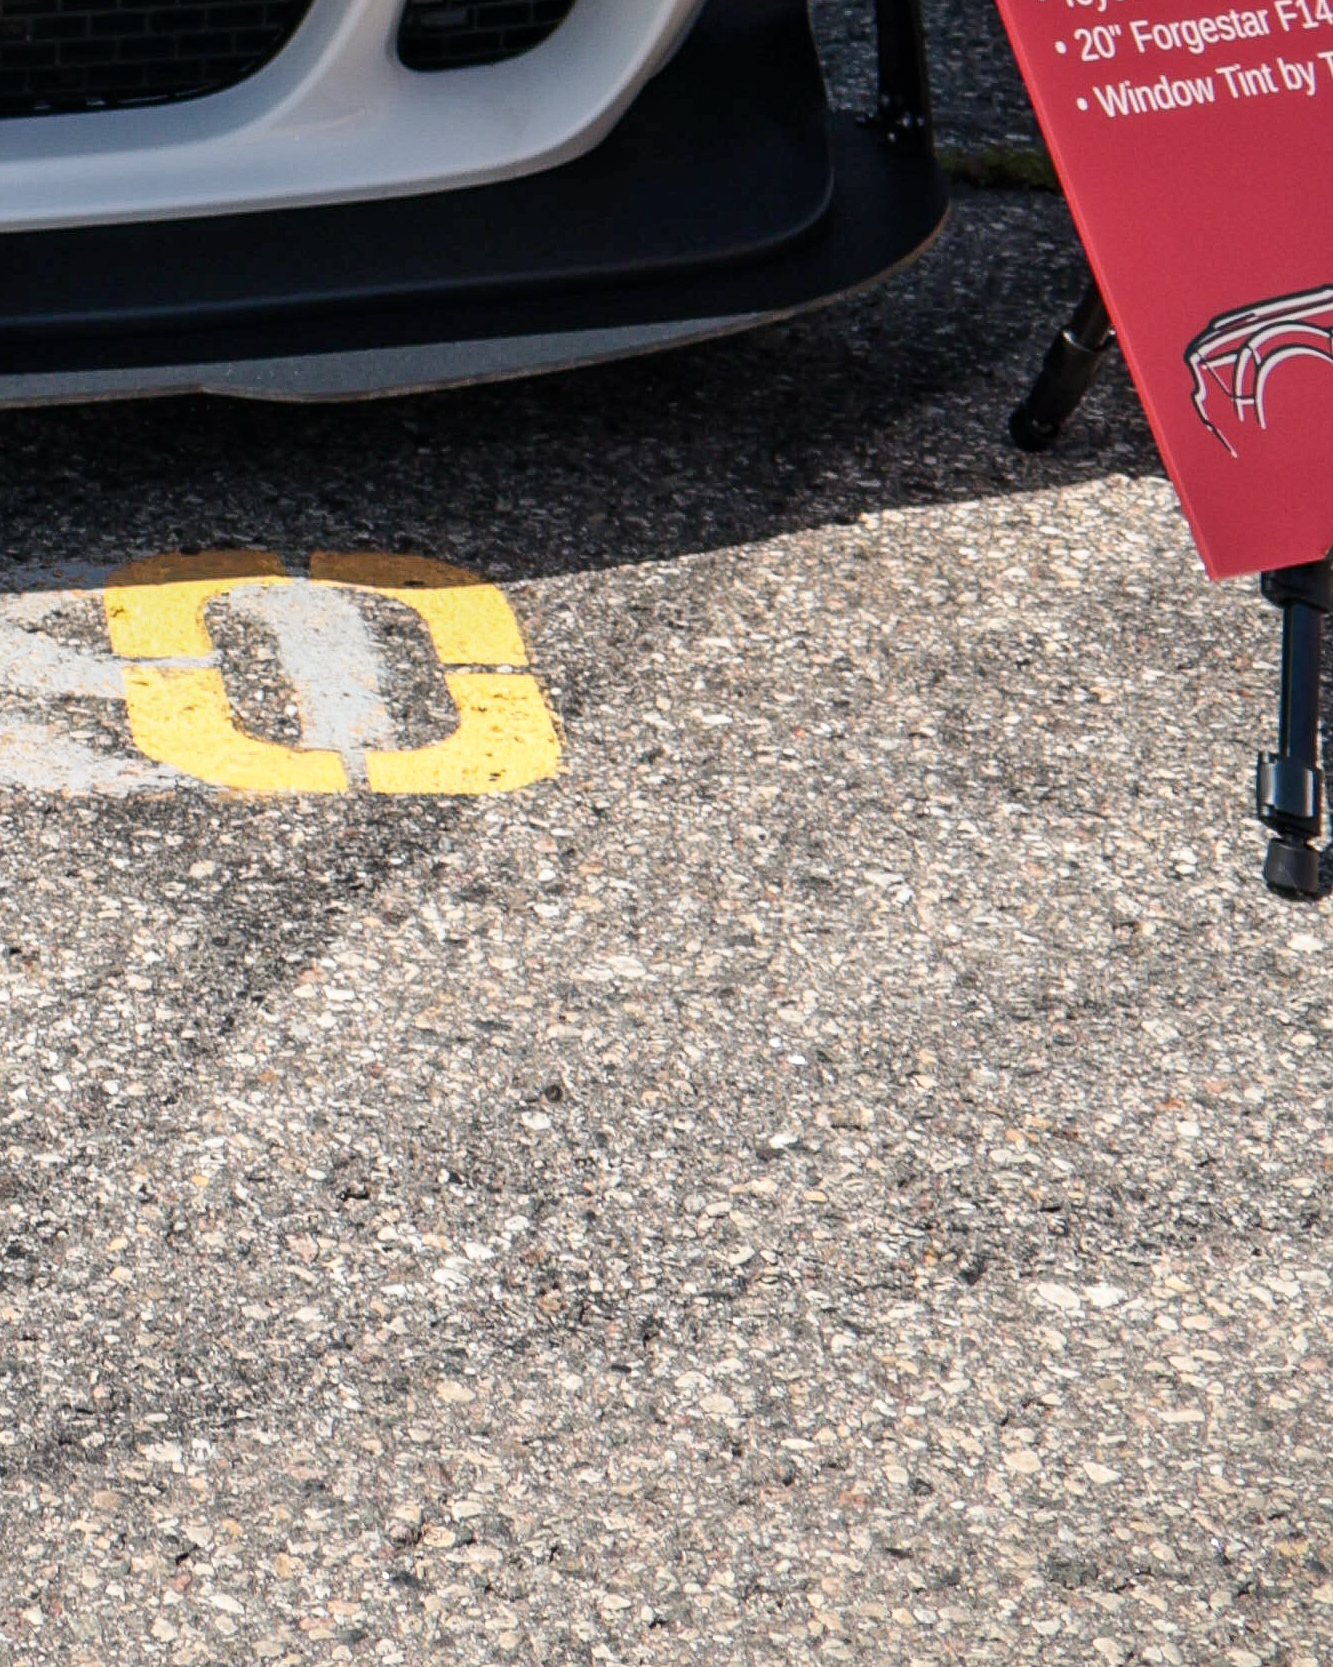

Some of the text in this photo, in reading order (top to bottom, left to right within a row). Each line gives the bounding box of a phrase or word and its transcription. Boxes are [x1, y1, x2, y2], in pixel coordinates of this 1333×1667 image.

[1129, 9, 1270, 54] Forgestar
[1093, 75, 1215, 117] Window
[1215, 63, 1279, 98] Tint
[1277, 57, 1315, 96] by
